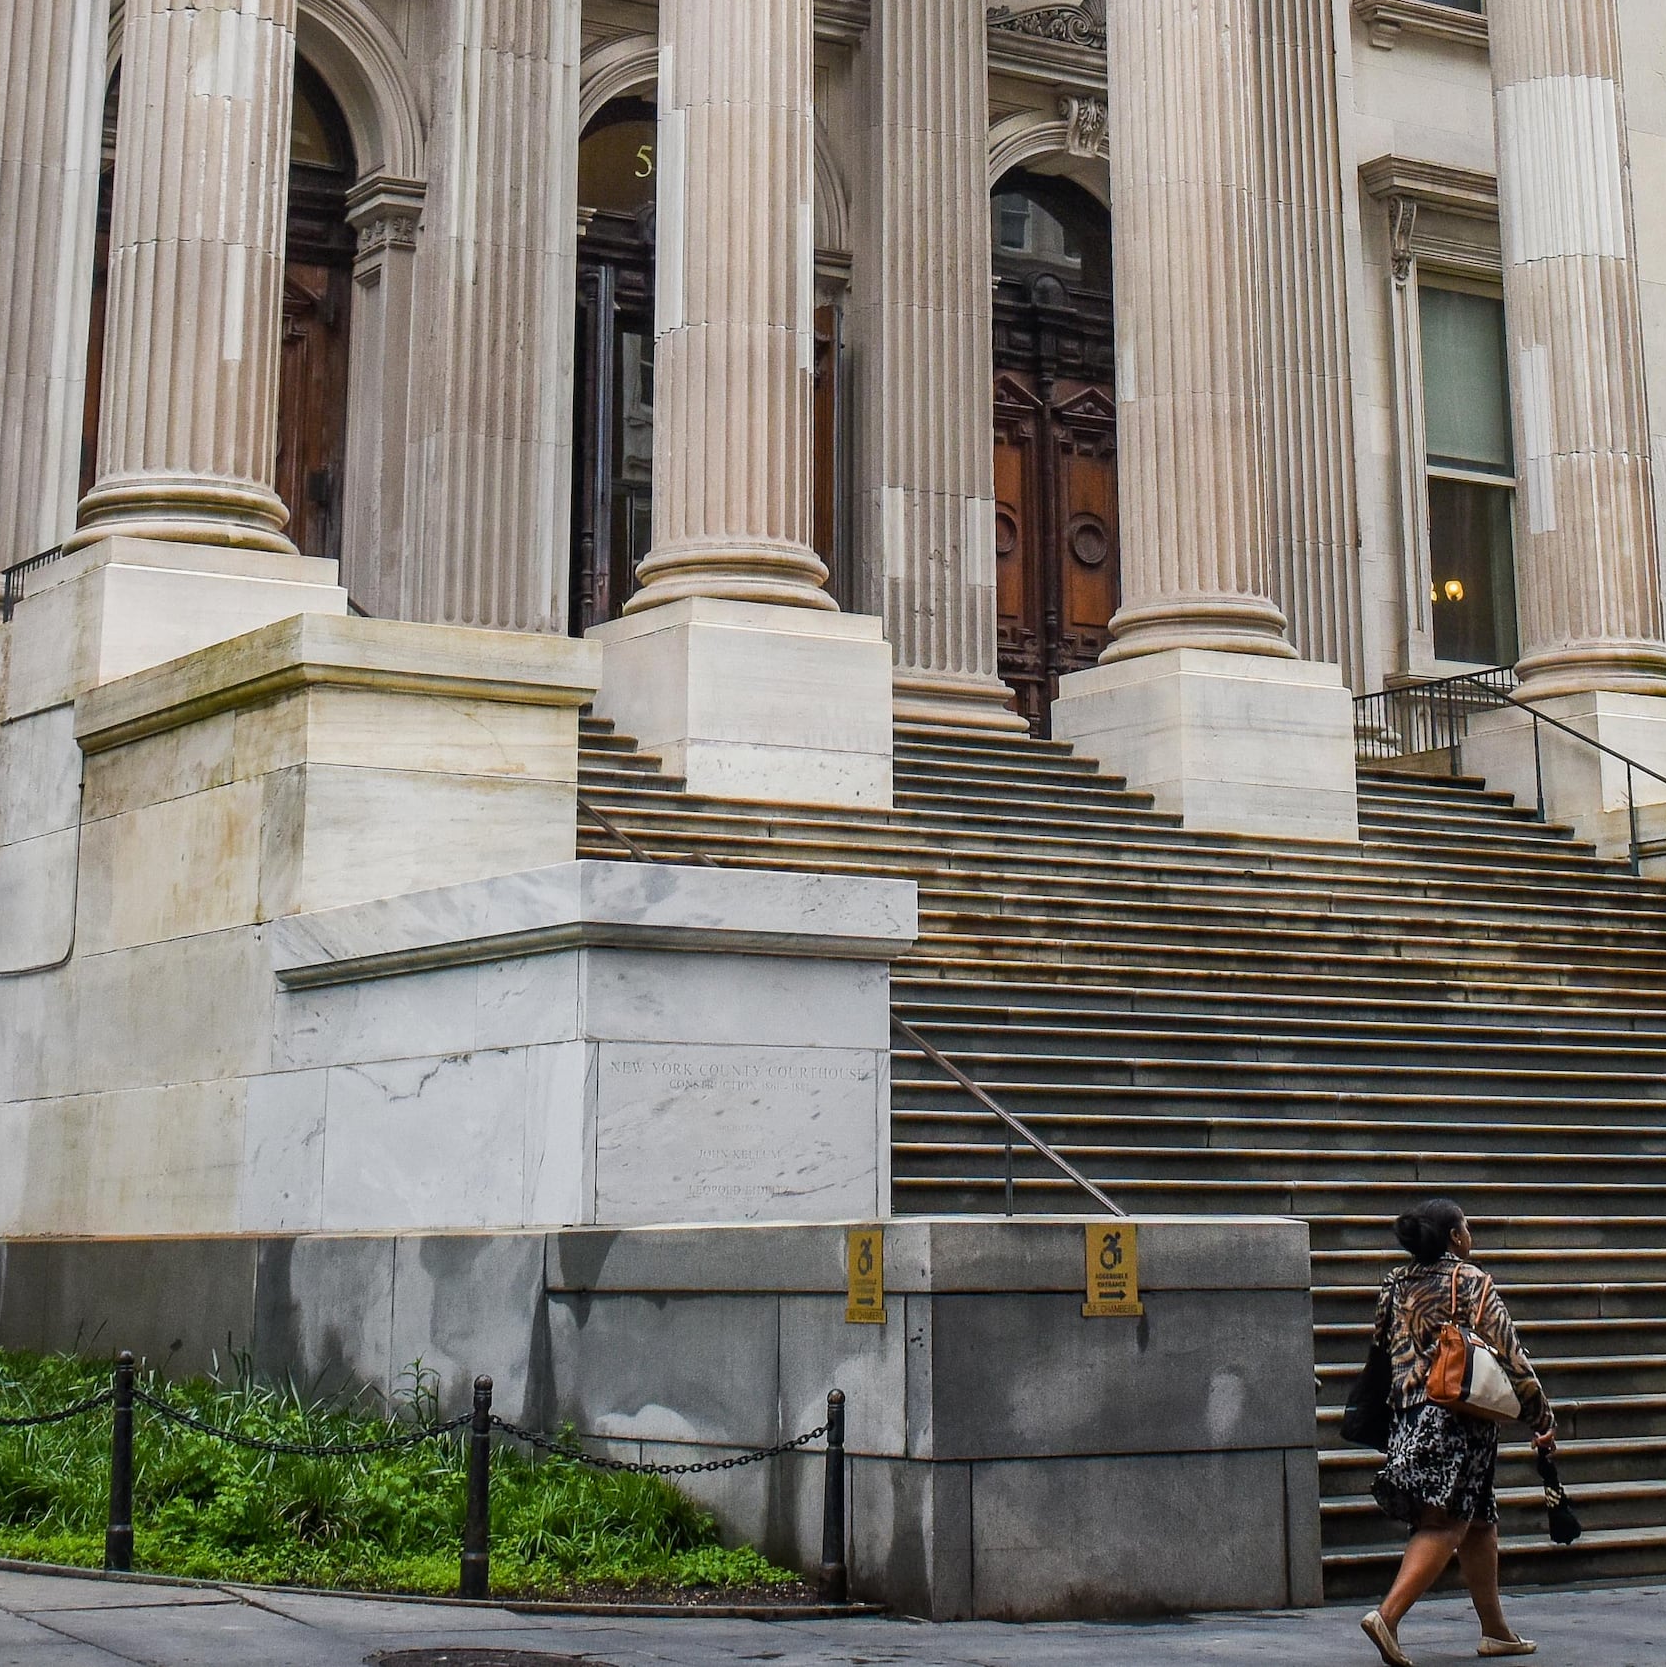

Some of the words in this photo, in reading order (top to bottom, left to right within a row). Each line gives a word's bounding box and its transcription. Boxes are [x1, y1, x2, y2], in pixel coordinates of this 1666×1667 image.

[610, 1061, 644, 1075] NEW
[652, 1062, 693, 1076] YORK
[699, 1063, 761, 1078] COUNTY
[768, 1065, 863, 1081] COURTHOUSE
[698, 1149, 729, 1160] JOHN
[733, 1149, 780, 1161] KELLUM
